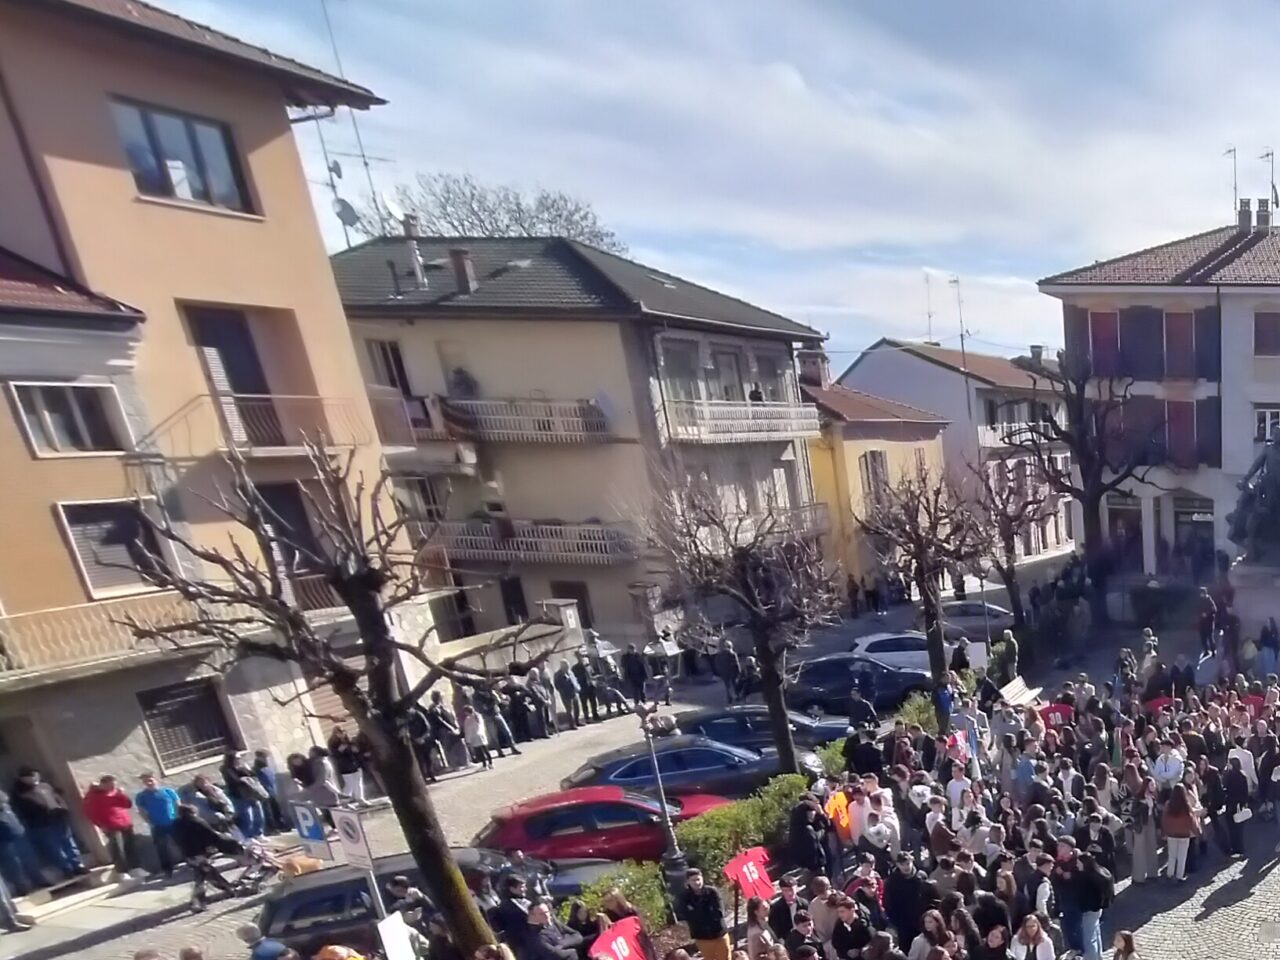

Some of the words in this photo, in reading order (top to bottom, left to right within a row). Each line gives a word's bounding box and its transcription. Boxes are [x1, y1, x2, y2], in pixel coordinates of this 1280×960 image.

[294, 806, 315, 838] P
[742, 861, 760, 883] 15
[611, 936, 630, 960] 10
